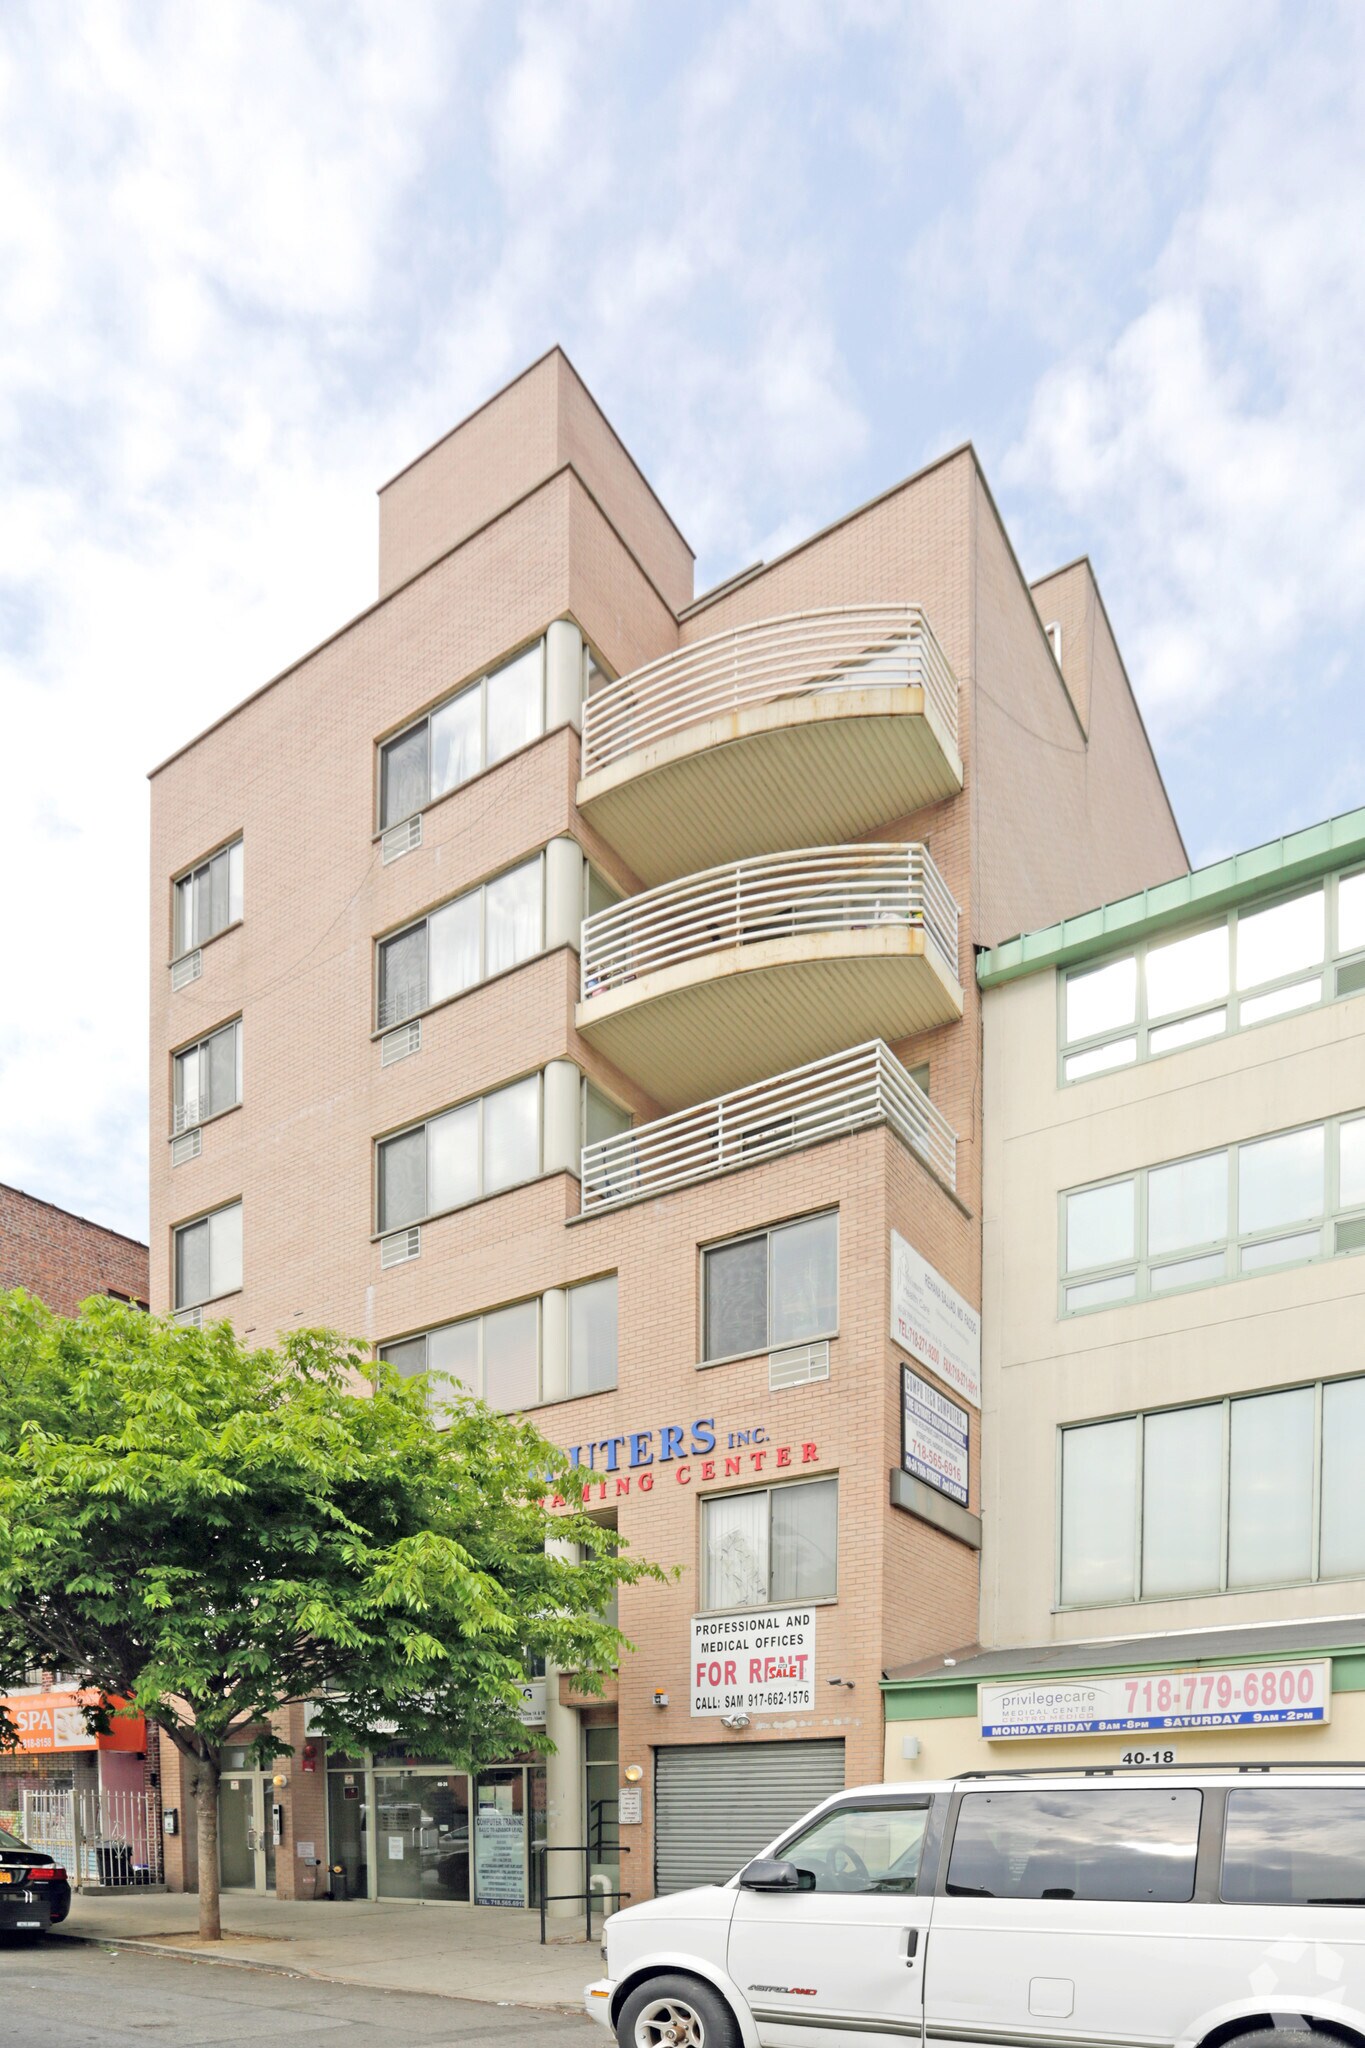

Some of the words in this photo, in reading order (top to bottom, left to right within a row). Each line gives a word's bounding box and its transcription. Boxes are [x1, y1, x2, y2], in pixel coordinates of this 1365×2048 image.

[728, 1426, 770, 1449] INC.
[675, 1442, 819, 1485] CENTER
[911, 1437, 961, 1483] 718-565-6916
[696, 1618, 780, 1636] PROFESSIONAL
[786, 1614, 810, 1627] AND
[701, 1639, 749, 1653] MEDICAL
[755, 1634, 804, 1648] OFFICES
[696, 1660, 737, 1688] FOR
[749, 1654, 808, 1684] RET
[768, 1665, 797, 1679] SALE
[695, 1696, 720, 1710] CALL:
[725, 1695, 744, 1708] SAM
[748, 1690, 810, 1707] 917-662-1576
[1002, 1691, 1096, 1709] privilegecare
[1124, 1668, 1314, 1713] 718-779-6800
[16, 1710, 53, 1731] SPA
[1002, 1709, 1048, 1717] MEDICAL
[1053, 1706, 1095, 1714] CENTER
[1002, 1715, 1046, 1723] CENTRO
[1050, 1712, 1095, 1721] MEDICO
[991, 1722, 1093, 1736] MONDAY-FRIDAY
[1098, 1721, 1121, 1731] 8AM
[1163, 1714, 1242, 1727] SATURDAY
[1253, 1713, 1279, 1723] 9AM
[1122, 1751, 1175, 1765] 40-18
